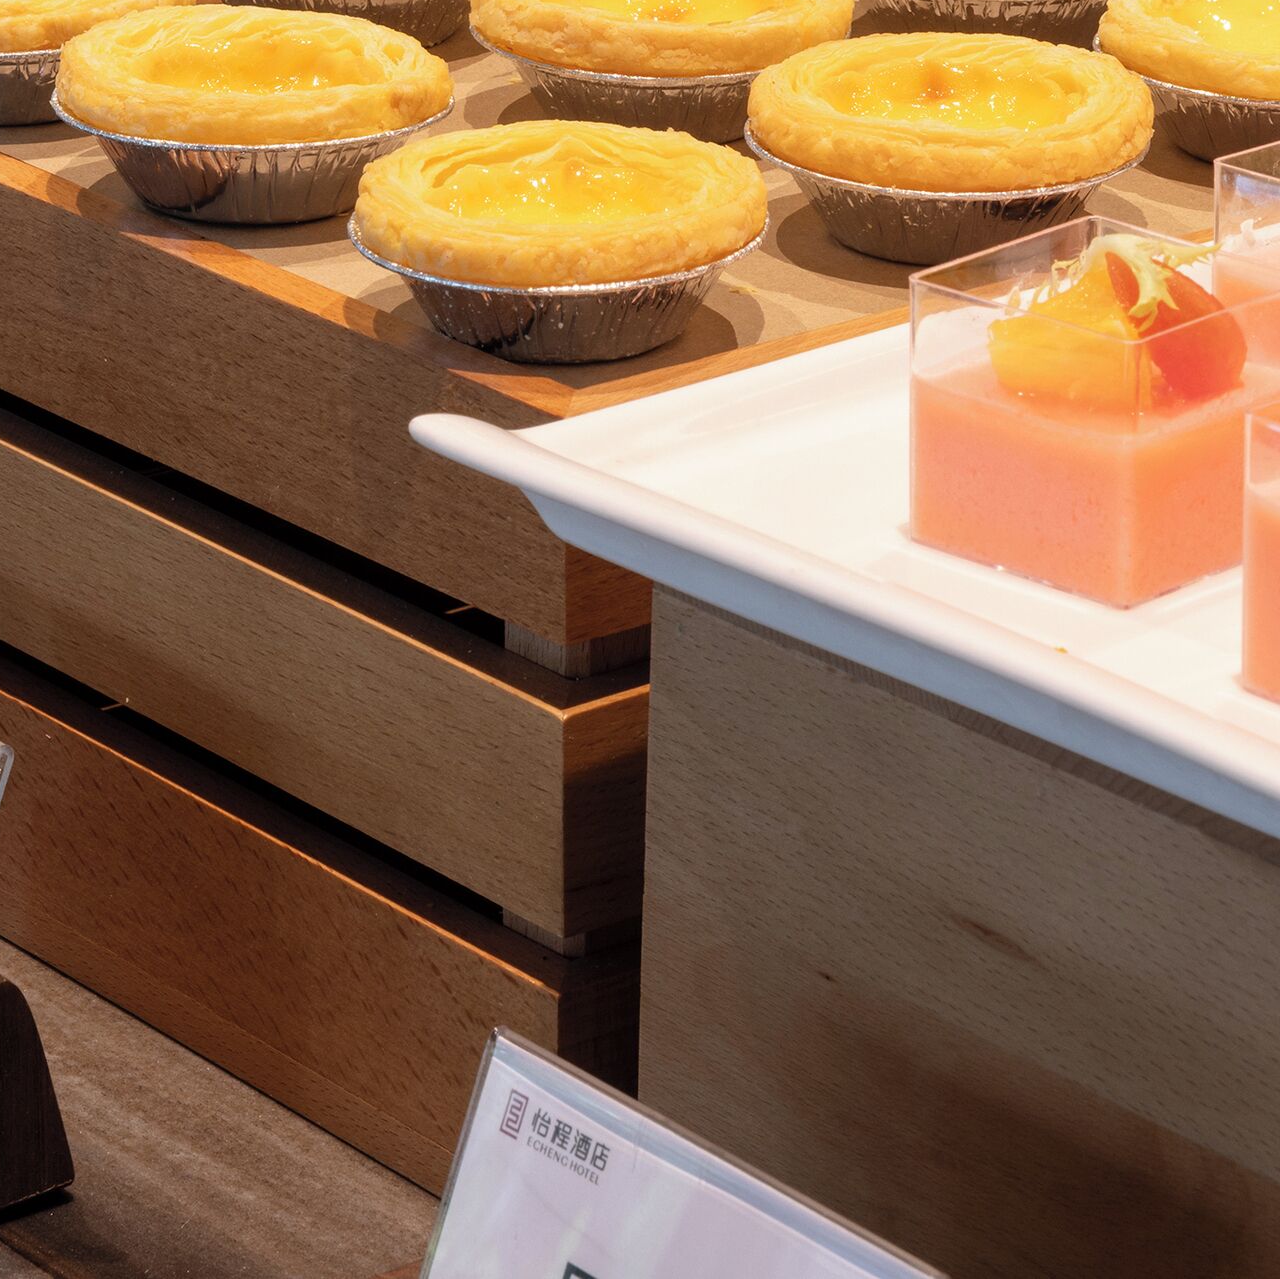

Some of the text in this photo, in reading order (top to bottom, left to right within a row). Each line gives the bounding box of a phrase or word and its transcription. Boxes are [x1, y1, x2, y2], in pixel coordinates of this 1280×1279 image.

[526, 1136, 600, 1186] ECHENG HOTEL
[532, 1107, 611, 1172] 怡程酒店
